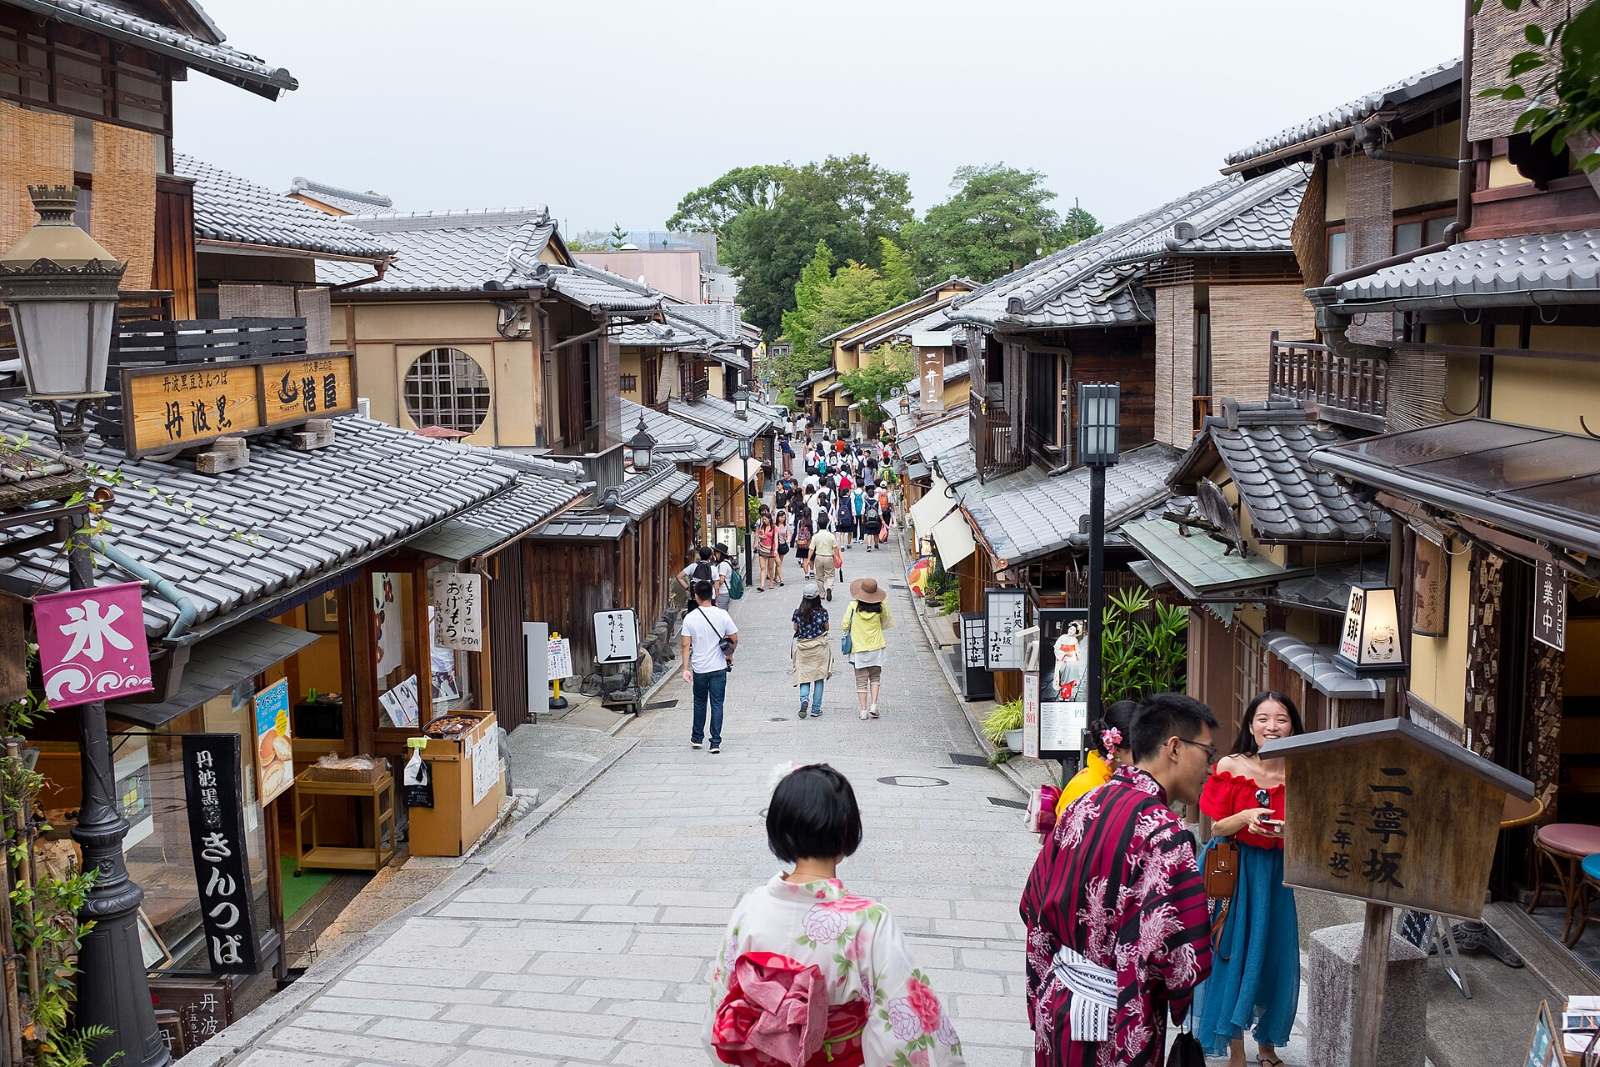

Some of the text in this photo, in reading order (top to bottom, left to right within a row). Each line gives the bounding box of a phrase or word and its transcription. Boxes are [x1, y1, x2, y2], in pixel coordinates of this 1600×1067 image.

[165, 394, 231, 440] 丹波黒
[302, 373, 337, 412] 港屋
[59, 600, 134, 662] 氷
[1347, 593, 1362, 641] 珈琲
[1362, 768, 1413, 888] 二寧坂
[201, 832, 243, 965] きんつば
